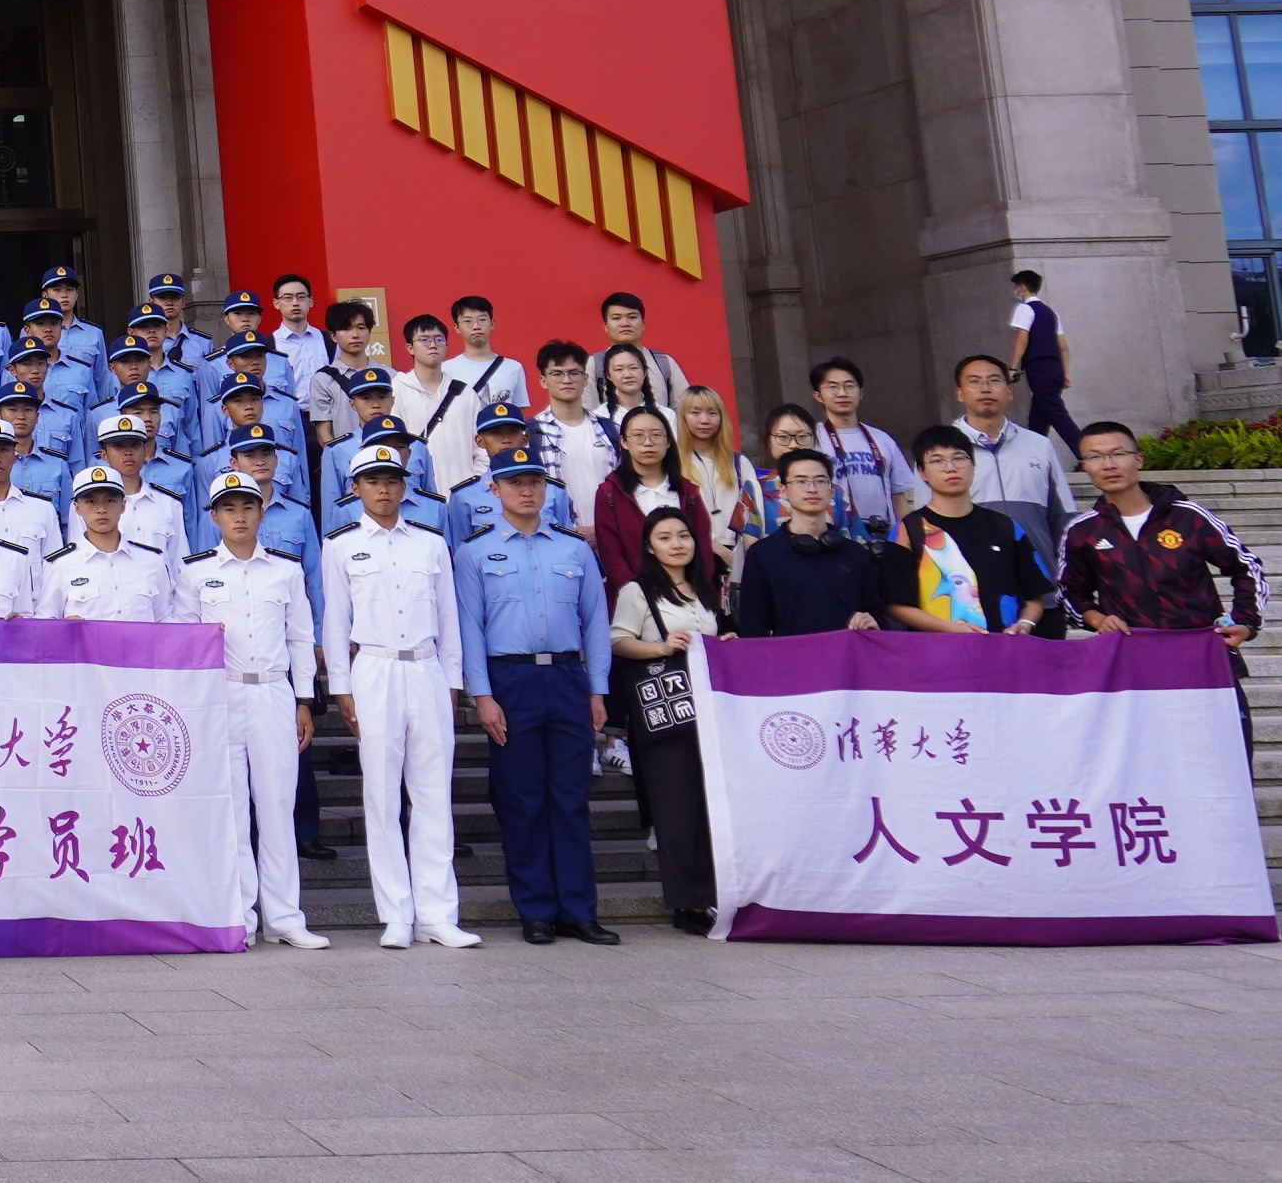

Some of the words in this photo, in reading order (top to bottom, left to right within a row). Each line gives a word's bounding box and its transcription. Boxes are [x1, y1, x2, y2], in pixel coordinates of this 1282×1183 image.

[163, 735, 182, 781] UNIVERSITY
[853, 796, 1177, 868] 人文学院
